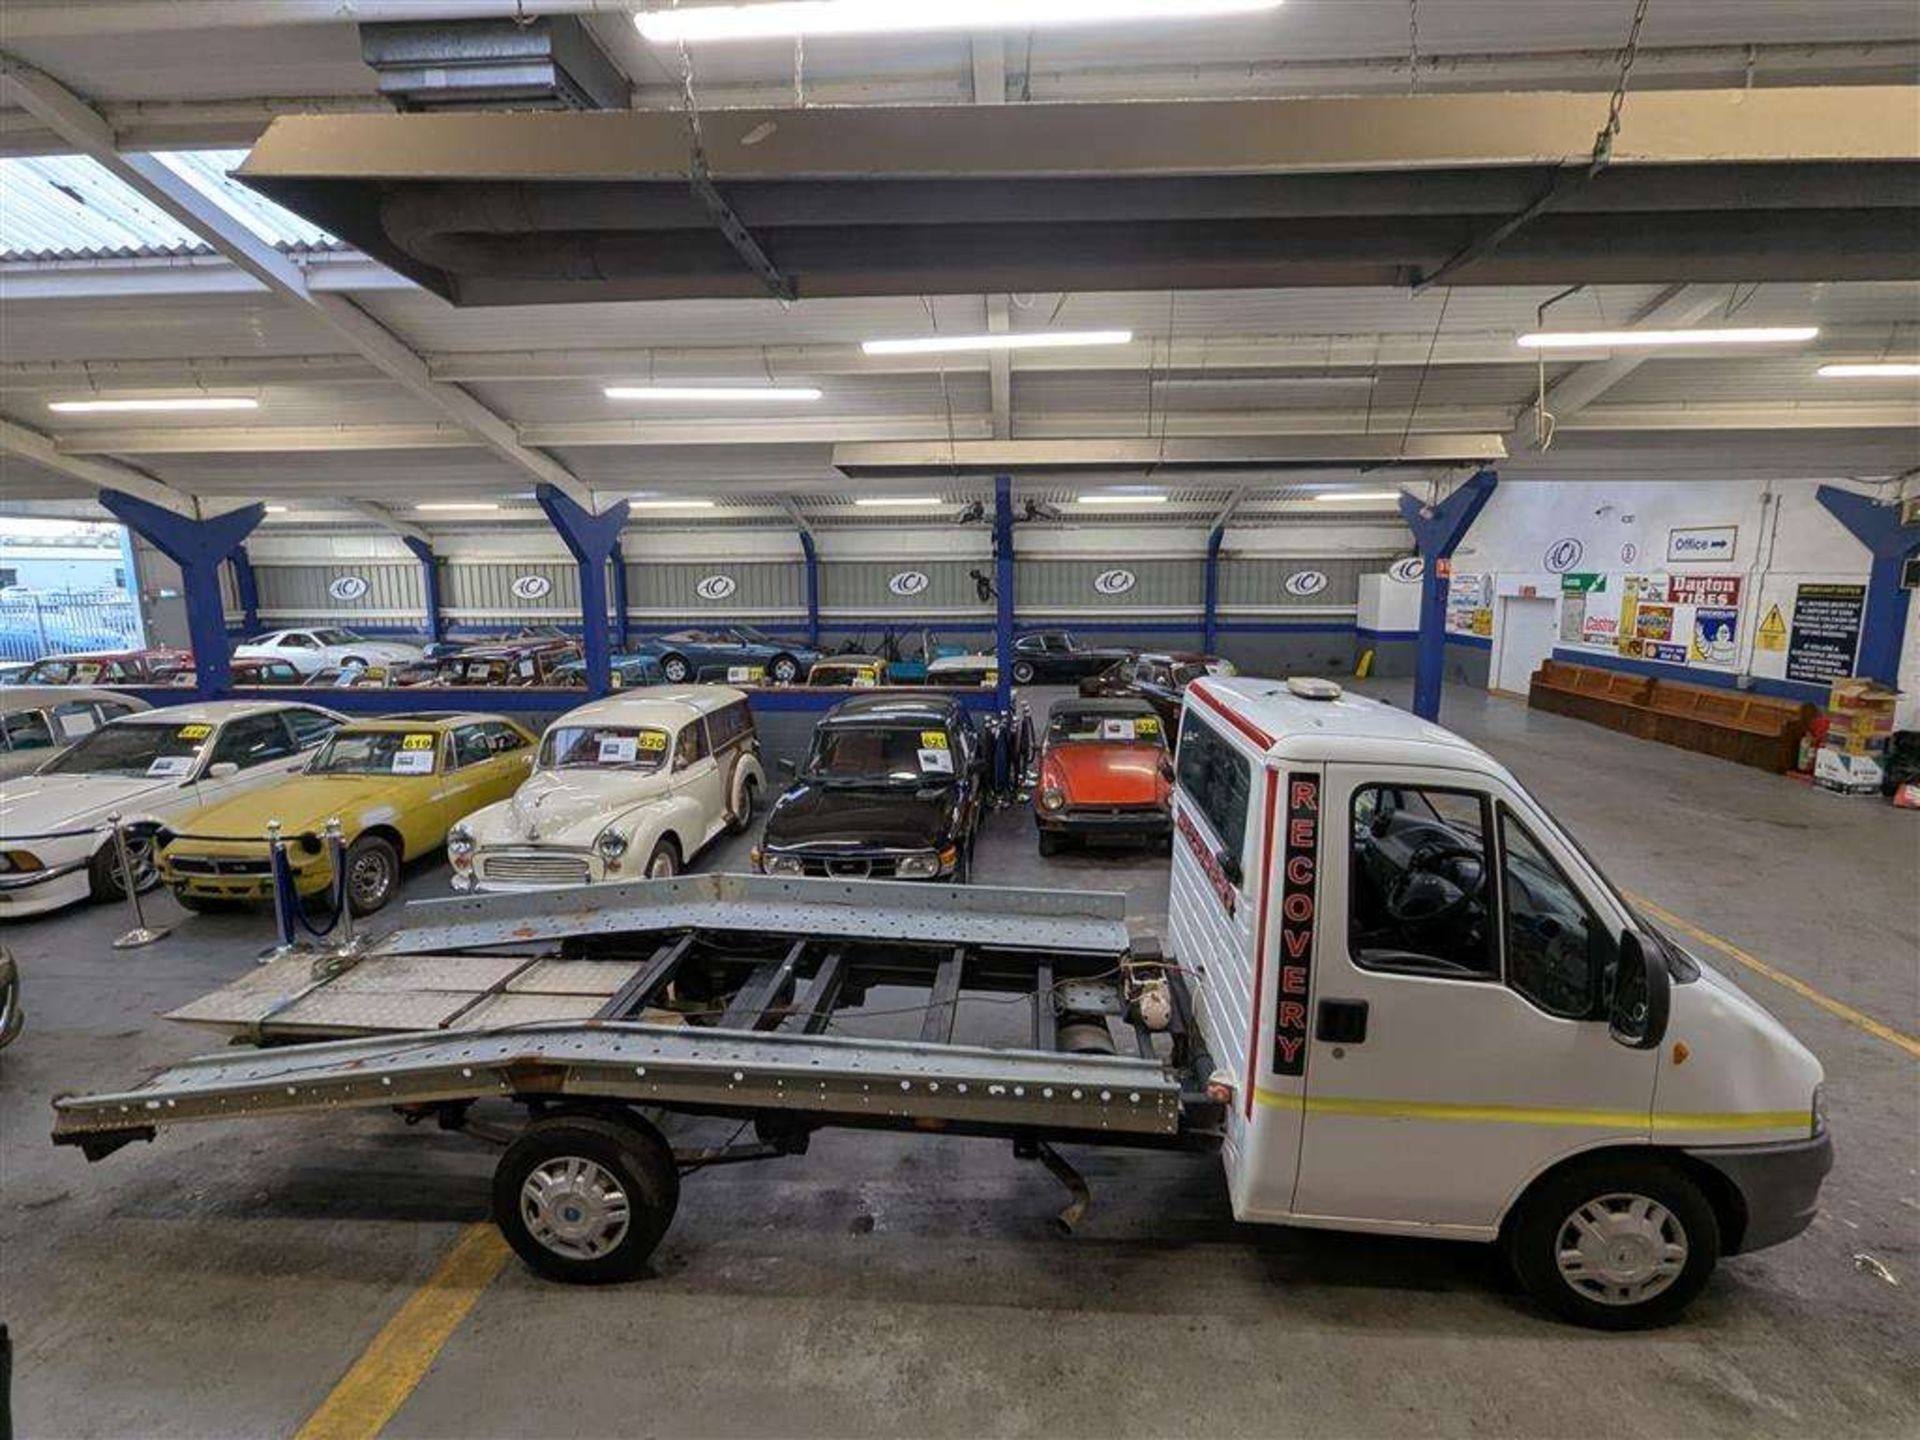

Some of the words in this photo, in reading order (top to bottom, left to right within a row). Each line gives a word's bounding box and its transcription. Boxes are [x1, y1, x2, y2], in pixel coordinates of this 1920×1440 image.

[1676, 538, 1708, 551] Office
[1673, 576, 1735, 593] Dayton
[1677, 592, 1728, 605] TIRES
[640, 737, 665, 748] 620
[1279, 781, 1317, 1063] RECOVERY
